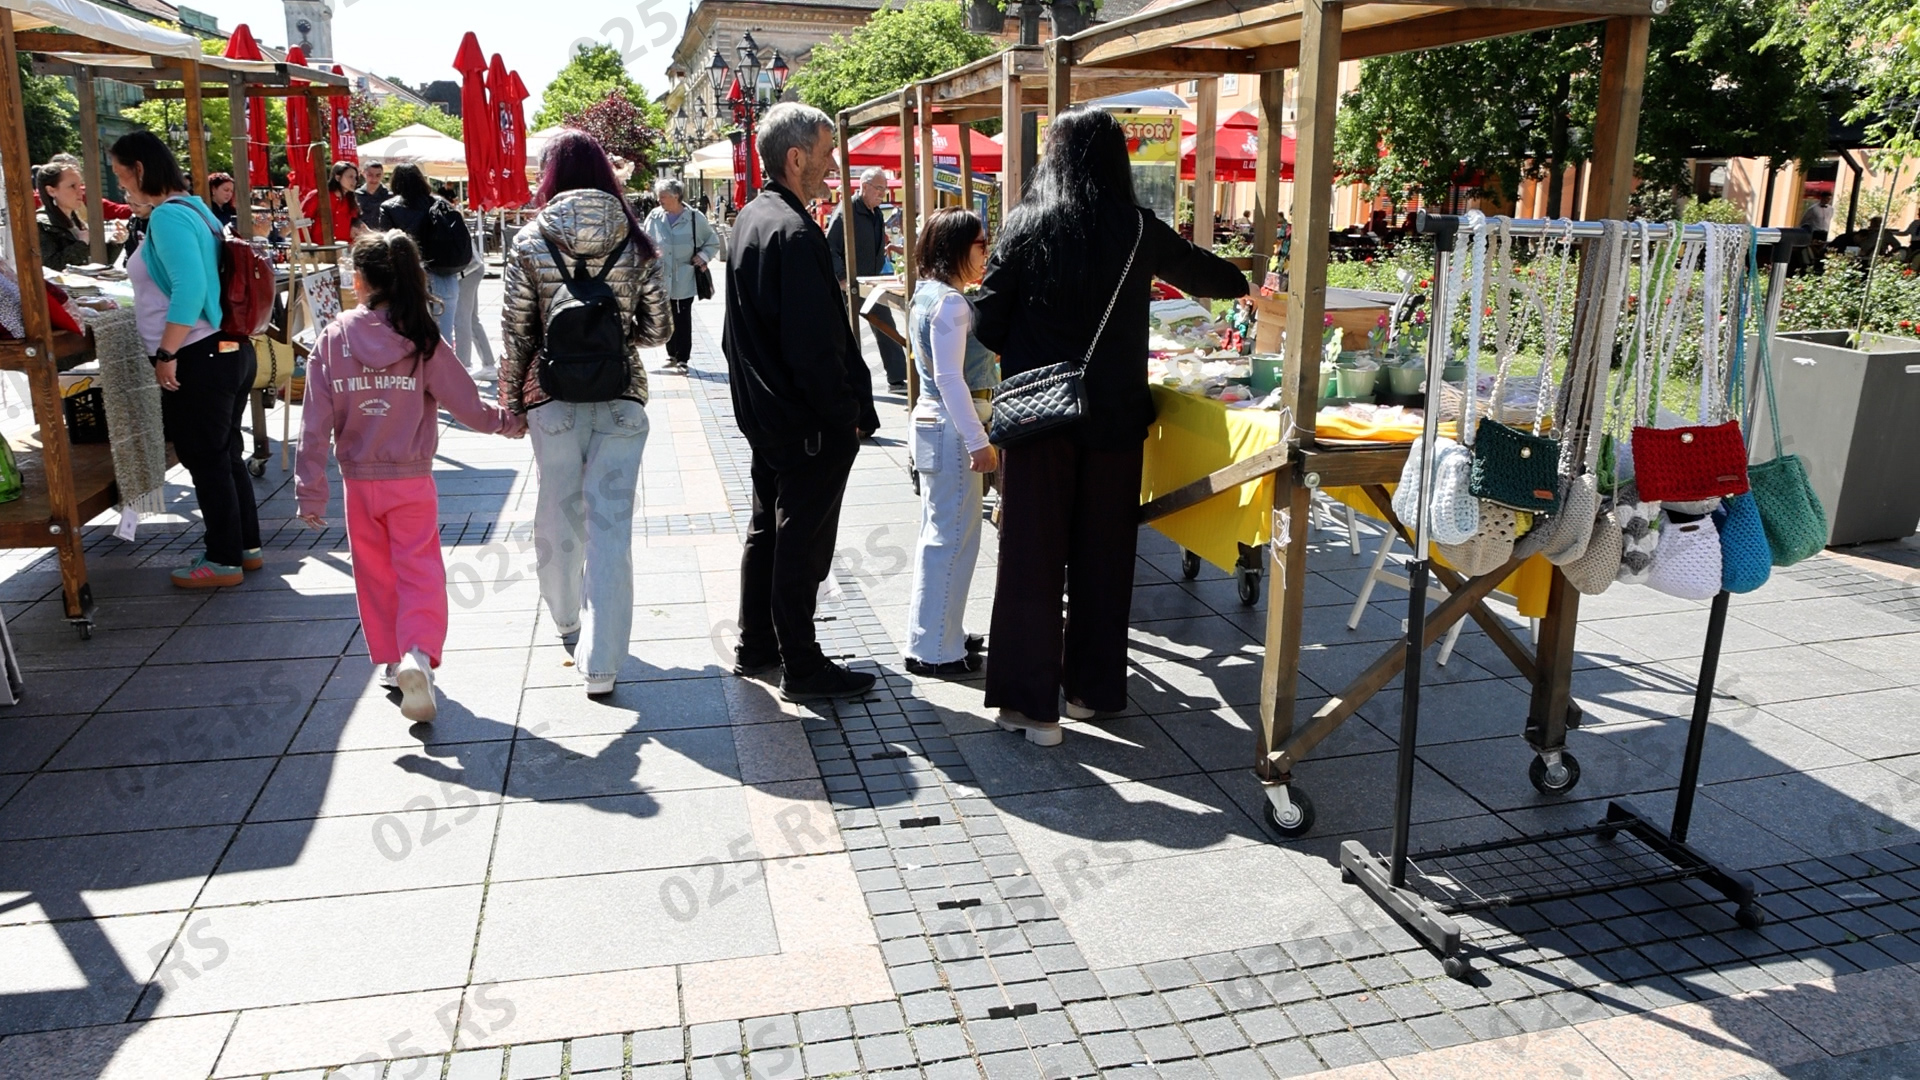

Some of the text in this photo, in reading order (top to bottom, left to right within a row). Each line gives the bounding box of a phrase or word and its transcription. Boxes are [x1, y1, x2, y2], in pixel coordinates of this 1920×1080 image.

[333, 375, 416, 393] IT WILL HAPPEN
